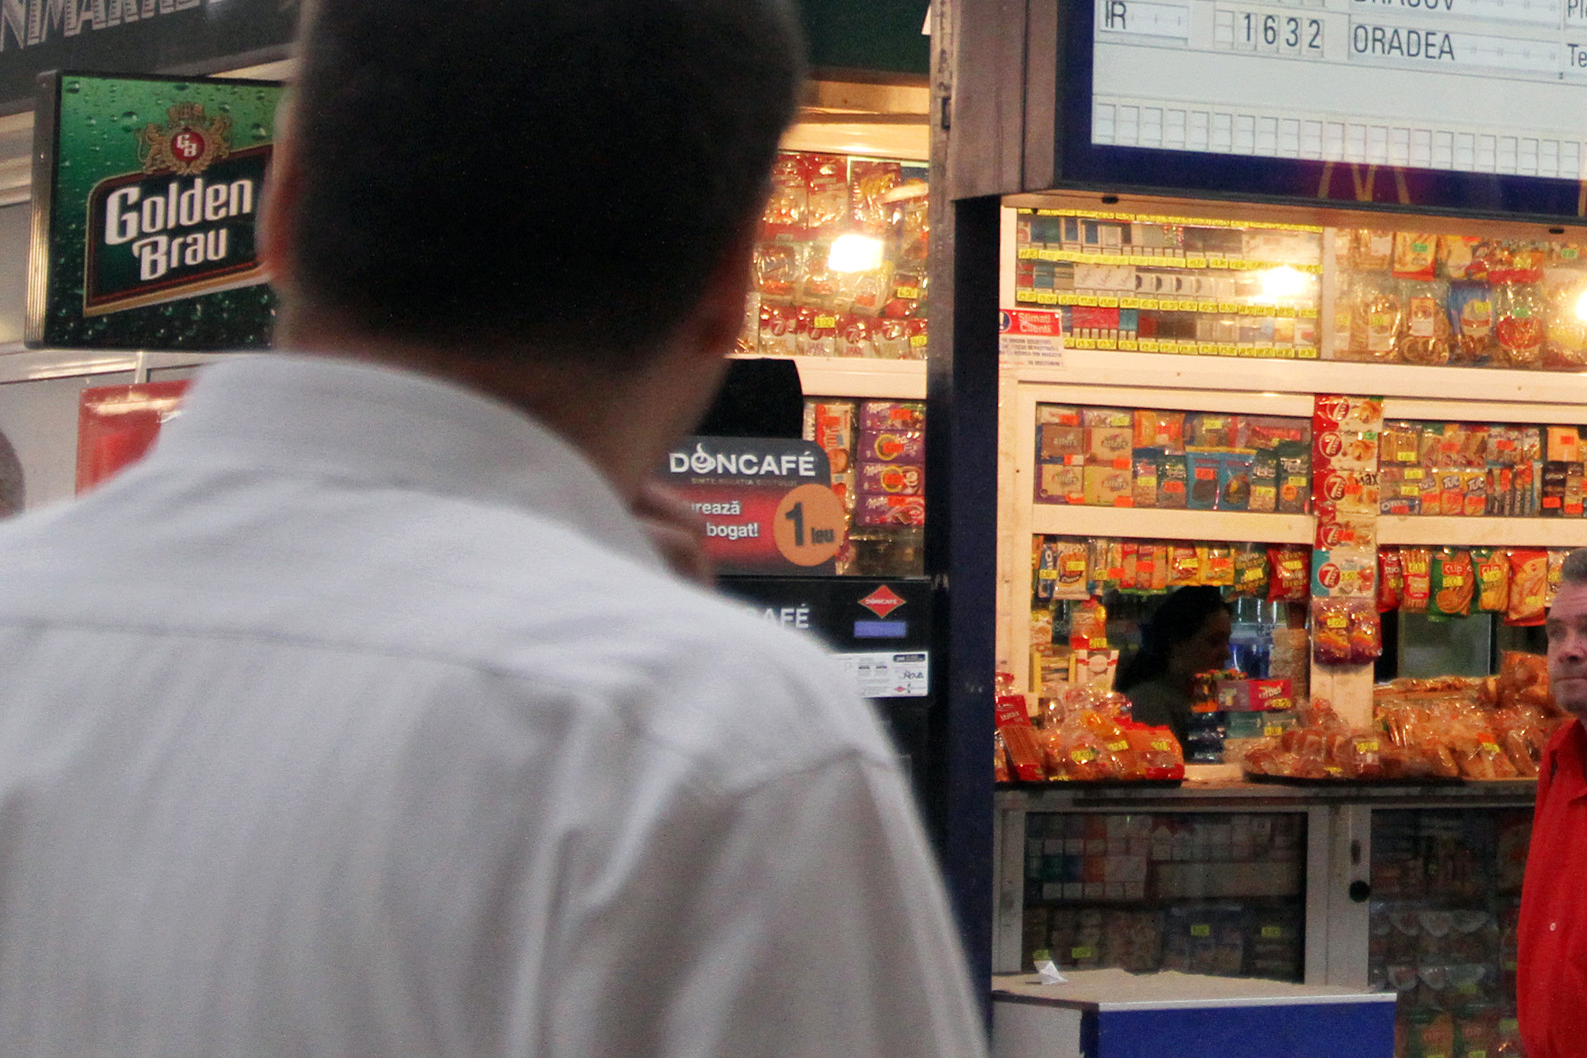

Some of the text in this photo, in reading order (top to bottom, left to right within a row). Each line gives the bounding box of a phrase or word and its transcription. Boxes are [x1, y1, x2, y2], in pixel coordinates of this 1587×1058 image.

[1104, 0, 1126, 29] IR
[1245, 13, 1321, 49] 1632
[1353, 25, 1455, 61] ORADEA
[105, 178, 253, 246] Golden
[133, 225, 228, 282] Brau
[669, 443, 816, 477] DONCAFÉ
[706, 522, 759, 541] bogat!
[785, 502, 804, 546] 1
